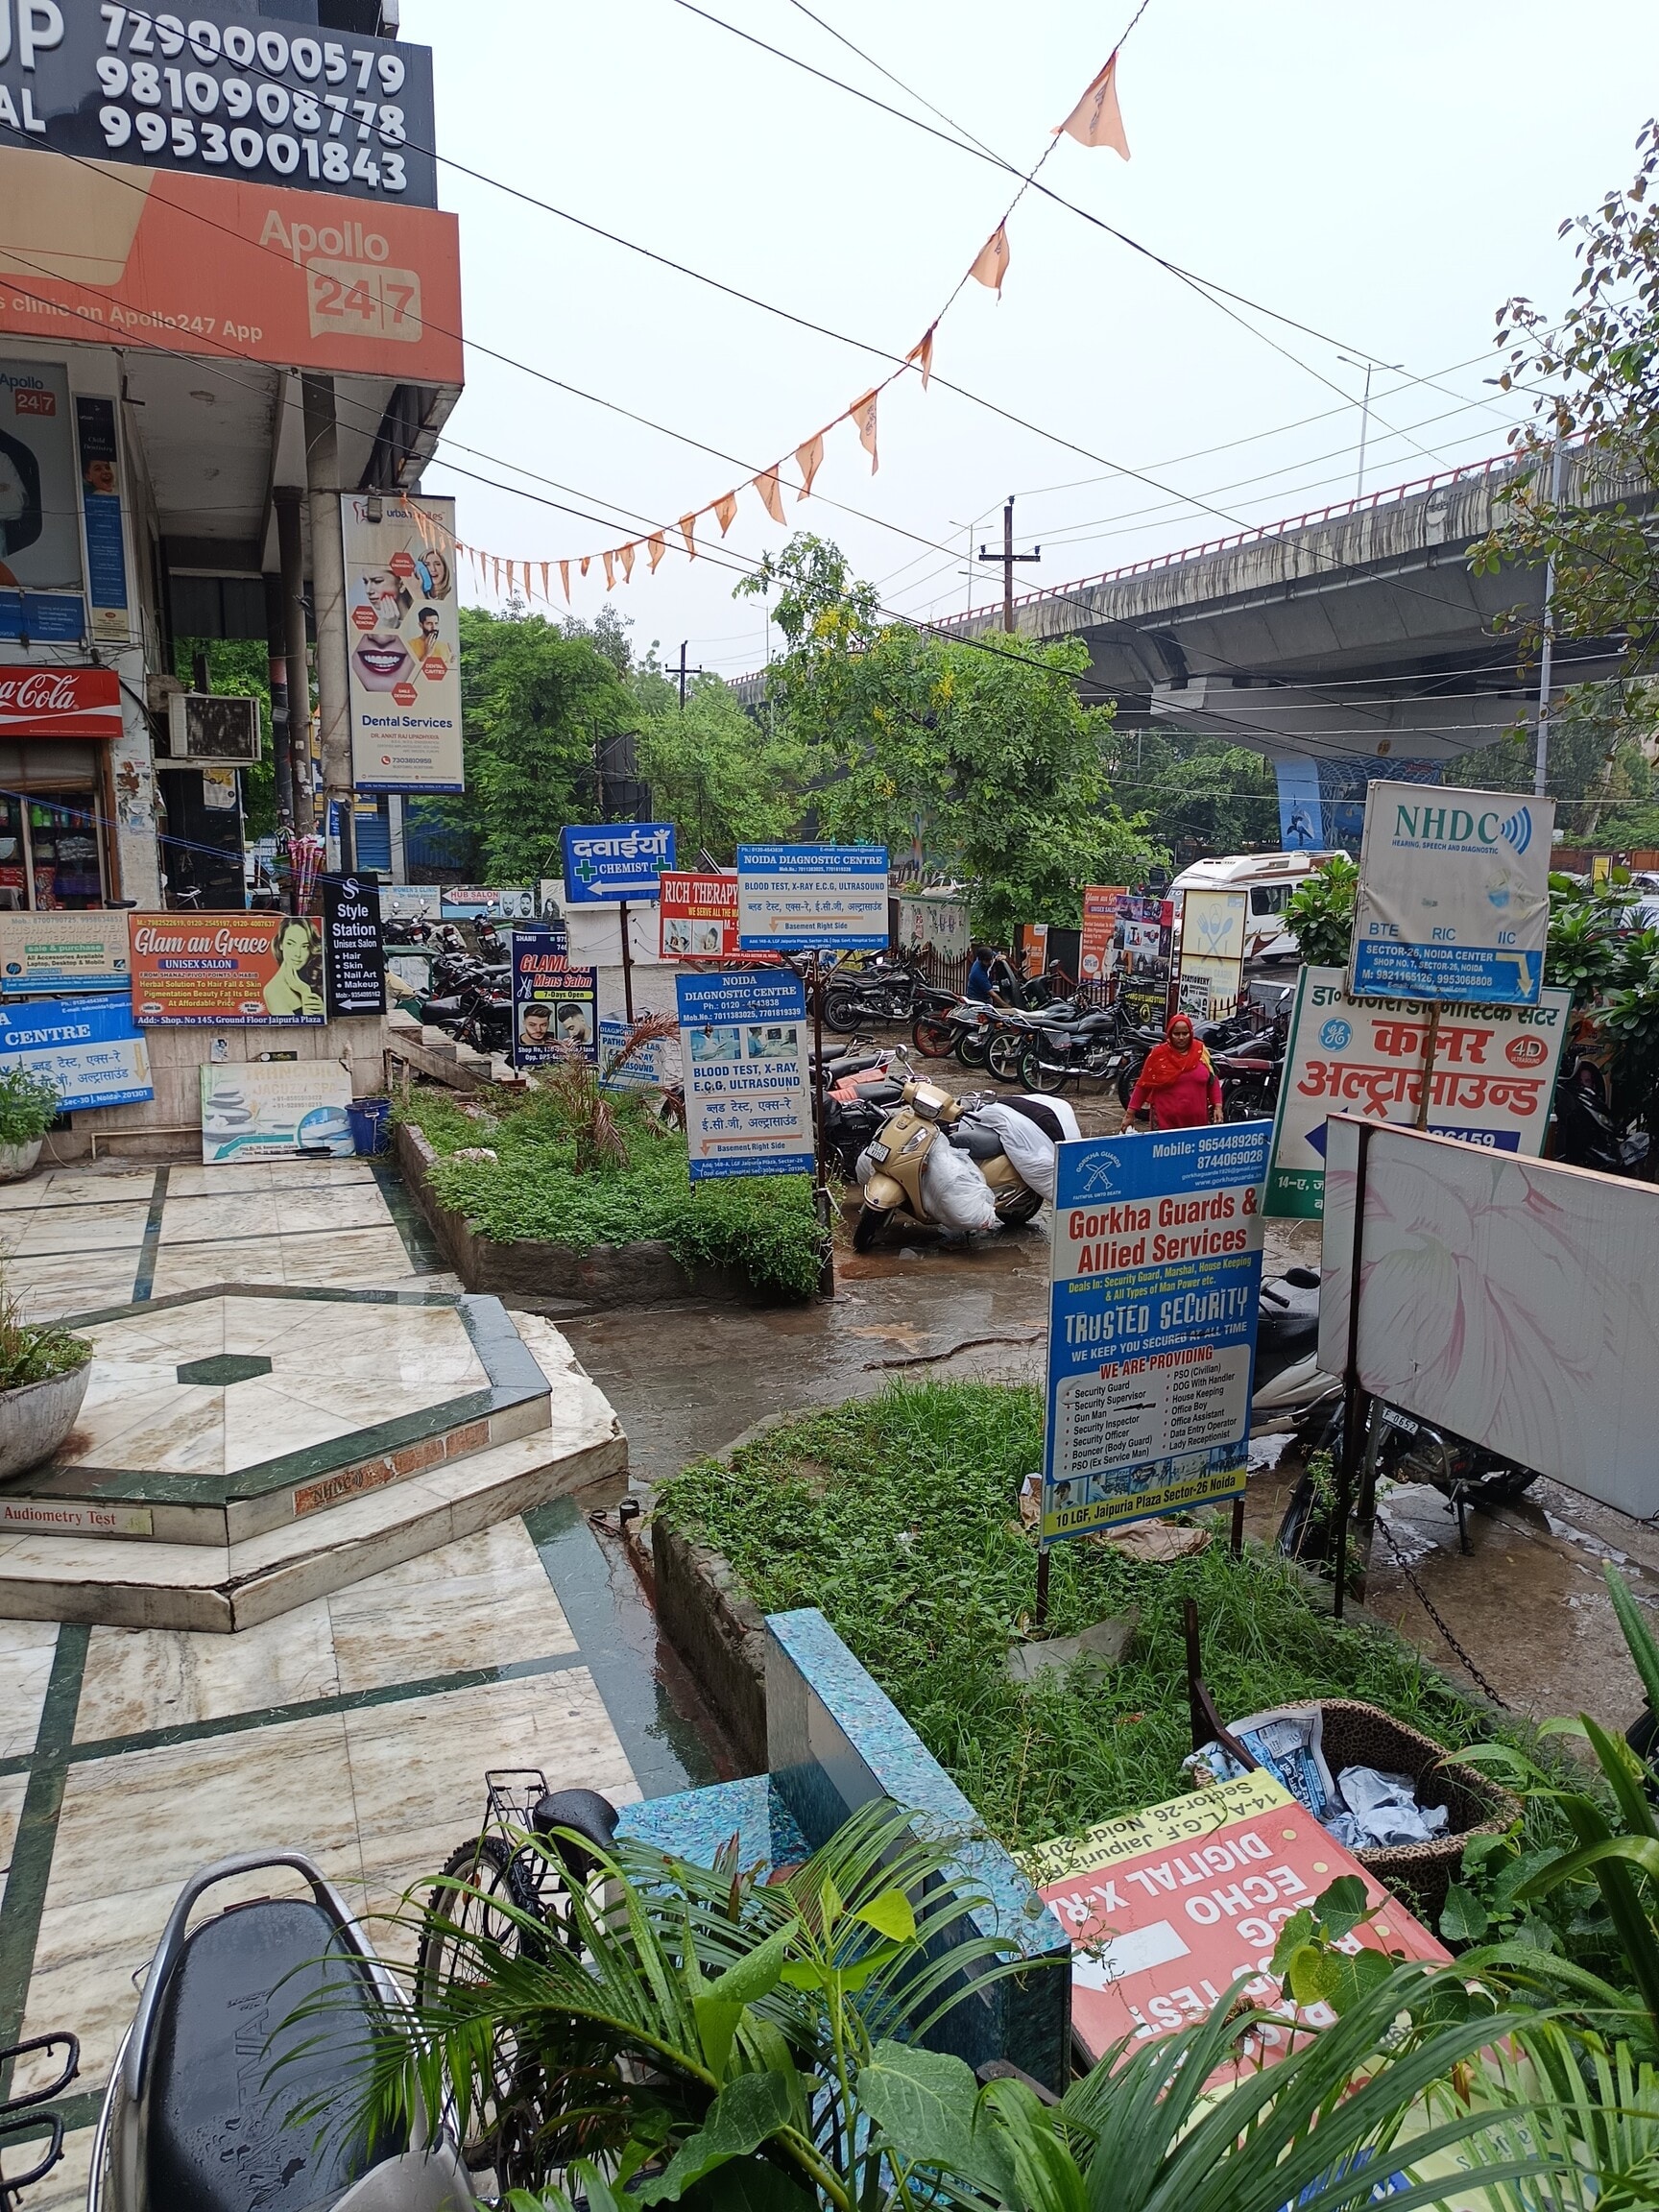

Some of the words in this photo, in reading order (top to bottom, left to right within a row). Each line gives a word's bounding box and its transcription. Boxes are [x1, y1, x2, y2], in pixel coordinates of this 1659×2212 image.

[101, 4, 405, 95] 7290000579
[96, 56, 407, 147] 9810908778
[99, 106, 407, 191] 9953001843
[258, 210, 390, 270] Apollo
[12, 295, 70, 317] clinic
[77, 304, 103, 322] on
[109, 306, 216, 334] Apollo247
[223, 320, 263, 343] App
[0, 373, 43, 392] Apollo
[362, 715, 399, 727] Dental
[402, 716, 452, 728] Services
[1394, 805, 1500, 845] NHDC
[572, 828, 670, 858] दवाईयाँ
[1423, 842, 1448, 851] SPEECH
[1461, 846, 1499, 854] DIAGNOSTIC
[599, 862, 649, 875] CHEMIST
[744, 855, 777, 864] NOIDA
[780, 855, 841, 864] DIAGNOSTIC
[843, 855, 882, 865] CENTRE
[664, 880, 690, 903] RICH
[693, 881, 738, 905] THERAPY
[338, 903, 369, 921] Style
[332, 923, 376, 936] Station
[817, 923, 833, 931] Right
[1369, 923, 1399, 937] BTE
[1432, 927, 1456, 941] RIC
[1498, 931, 1516, 945] IIC
[134, 926, 185, 955] Glam
[215, 928, 270, 956] Grace
[333, 940, 357, 949] Unisex
[358, 939, 376, 948] Salon
[1366, 945, 1422, 960] SECTOR-26,
[1424, 949, 1454, 959] NOIDA
[1455, 950, 1494, 962] CENTER
[165, 960, 200, 969] UNISEX
[201, 960, 231, 969] SALON
[1373, 958, 1395, 967] SHOP
[1461, 964, 1483, 973] NOIDA
[533, 974, 563, 987] Mens
[563, 974, 592, 988] Salon
[722, 976, 757, 986] NOIDA
[1376, 970, 1435, 986] 9821165126,
[1437, 974, 1493, 986] 9953068808
[685, 989, 751, 1001] DIAGNOSTIC
[753, 986, 796, 997] CENTRE
[268, 1016, 297, 1024] Jaipuria
[759, 1008, 801, 1017] 7701819339
[5, 1023, 91, 1046] CENTRE
[1371, 1020, 1495, 1064] कलर
[1512, 1039, 1542, 1057] 4D
[693, 1066, 730, 1077] BLOOD
[733, 1064, 761, 1075] TEST,
[764, 1062, 799, 1073] X-RAY,
[730, 1076, 801, 1090] ULTRASOUND
[122, 1090, 148, 1098] 201301
[752, 1142, 769, 1152] Right
[1153, 1142, 1195, 1158] Mobile:
[1198, 1133, 1264, 1152] 9654489266
[1076, 1152, 1099, 1173] GORKHA
[1101, 1151, 1121, 1168] GUARDS
[1197, 1149, 1262, 1169] 8744069028
[1194, 1172, 1262, 1187] www.gorkhaguards.in
[1069, 1204, 1151, 1240] Gorkha
[1158, 1191, 1235, 1228] Guards
[1241, 1187, 1258, 1216] &
[1077, 1237, 1145, 1275] Allied
[1152, 1227, 1247, 1263] Services
[1069, 1282, 1091, 1294] Deals
[1104, 1273, 1137, 1288] Security
[1138, 1269, 1163, 1282] Guard,
[1164, 1264, 1197, 1278] Marshal,
[1199, 1262, 1221, 1273] House
[1222, 1256, 1252, 1270] Keeping
[1126, 1285, 1148, 1300] Types
[1159, 1282, 1176, 1294] Man
[1177, 1278, 1200, 1290] Power
[1064, 1305, 1150, 1344] TRUSTED
[1091, 1347, 1117, 1359] KEEP
[1142, 1334, 1187, 1351] SECURED
[1224, 1322, 1247, 1334] TIME
[1151, 1345, 1213, 1370] PROVIDING
[1190, 1362, 1221, 1378] (Civilian)
[1190, 1378, 1207, 1388] With
[1209, 1372, 1235, 1385] Handler
[1074, 1387, 1105, 1399] Security
[1107, 1381, 1130, 1393] Guard
[1107, 1390, 1146, 1406] Supervisor
[1106, 1415, 1140, 1430] Inspector
[1170, 1416, 1191, 1428] Office
[1192, 1408, 1225, 1422] Assistant
[1207, 1418, 1238, 1432] Operator
[1105, 1430, 1129, 1441] Officer
[1169, 1439, 1187, 1451] Lady
[1188, 1430, 1230, 1445] Receptionist
[1072, 1448, 1103, 1459] Bouncer
[1070, 1509, 1091, 1525] LGF,
[1094, 1499, 1133, 1520] Jaipuria
[1136, 1493, 1162, 1509] Plaza
[1164, 1482, 1208, 1503] Sector-26
[1211, 1475, 1236, 1490] Noida
[4, 1506, 83, 1526] Audiometry
[86, 1510, 117, 1526] Test
[1145, 1782, 1254, 1822] Sector-26,
[1125, 1832, 1274, 1897] DIGITAL
[1184, 1864, 1308, 1926] ECHO
